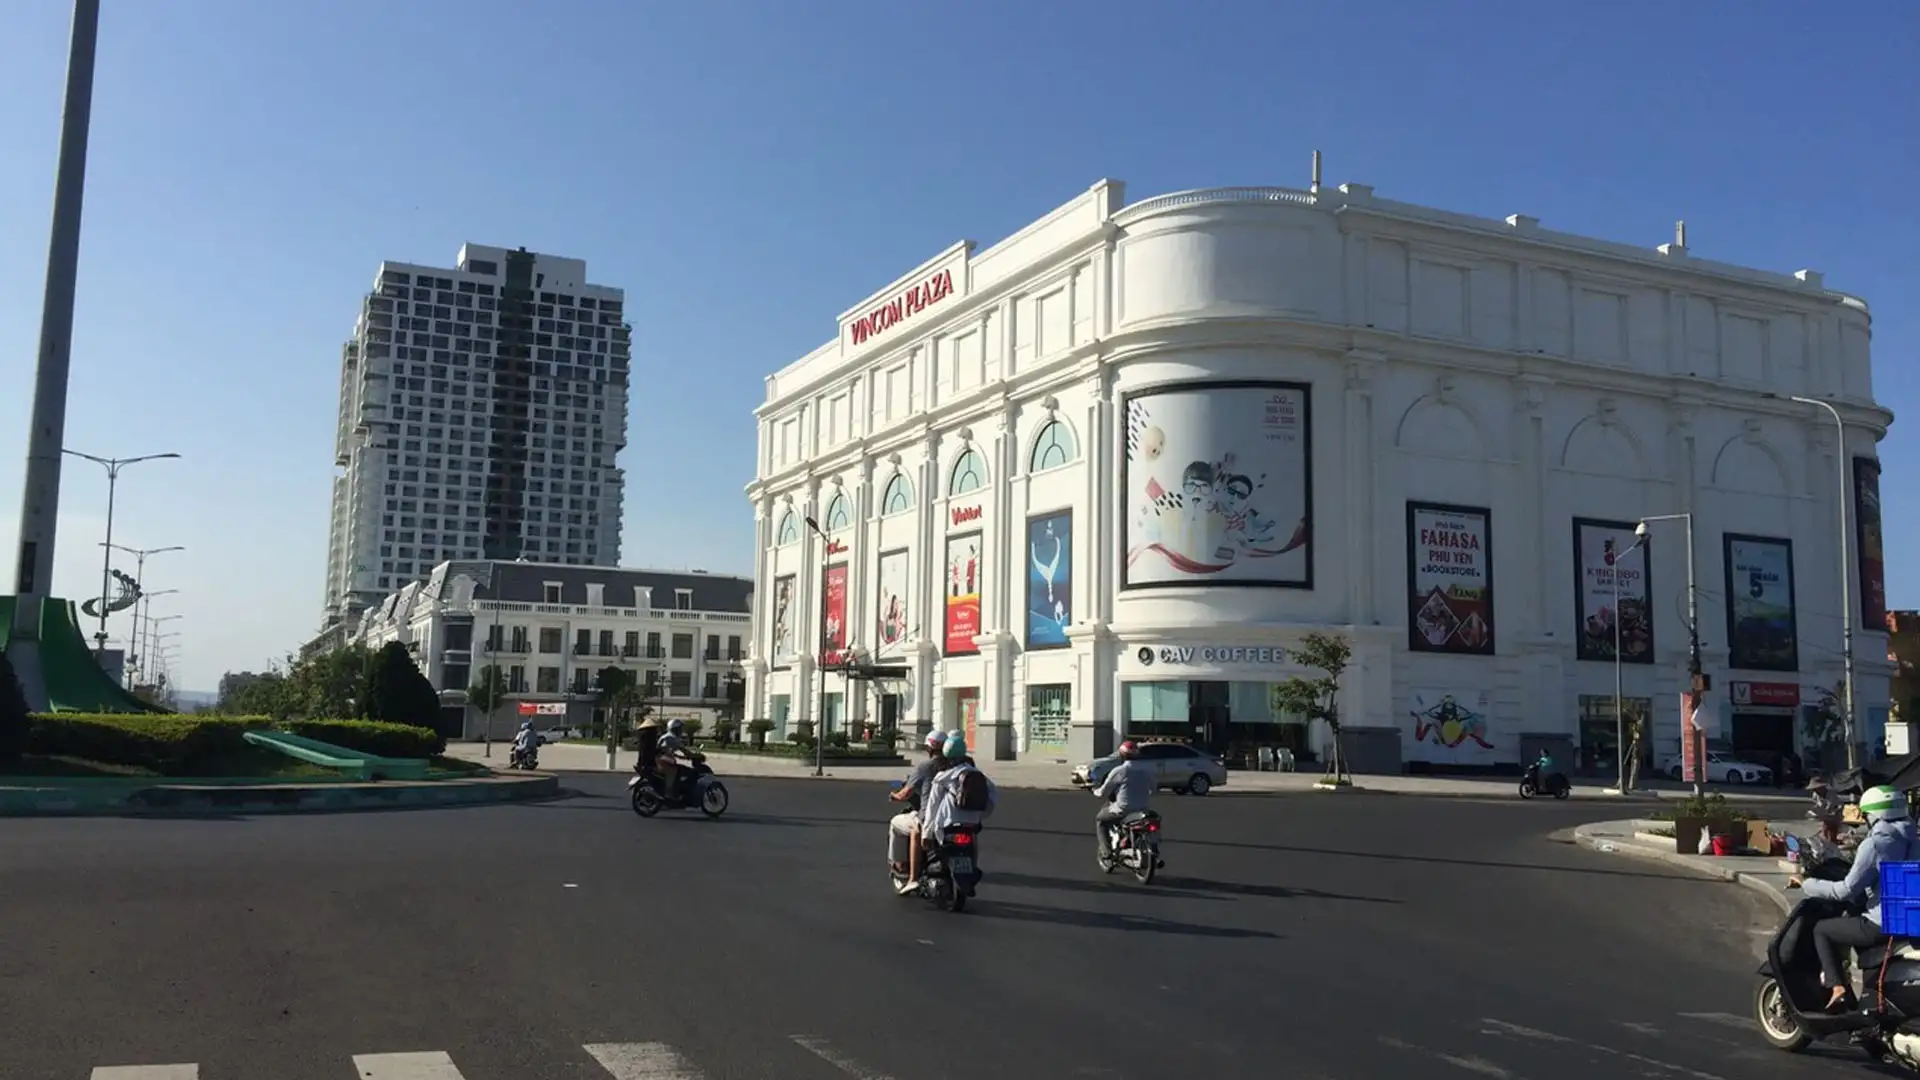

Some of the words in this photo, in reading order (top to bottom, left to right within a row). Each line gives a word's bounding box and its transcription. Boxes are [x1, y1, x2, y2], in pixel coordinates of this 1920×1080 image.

[851, 296, 904, 345] VINCOM
[906, 268, 954, 317] PLAZA
[1421, 528, 1479, 551] FAHASA
[1160, 647, 1195, 664] CAV
[1201, 646, 1286, 664] COFFEE
